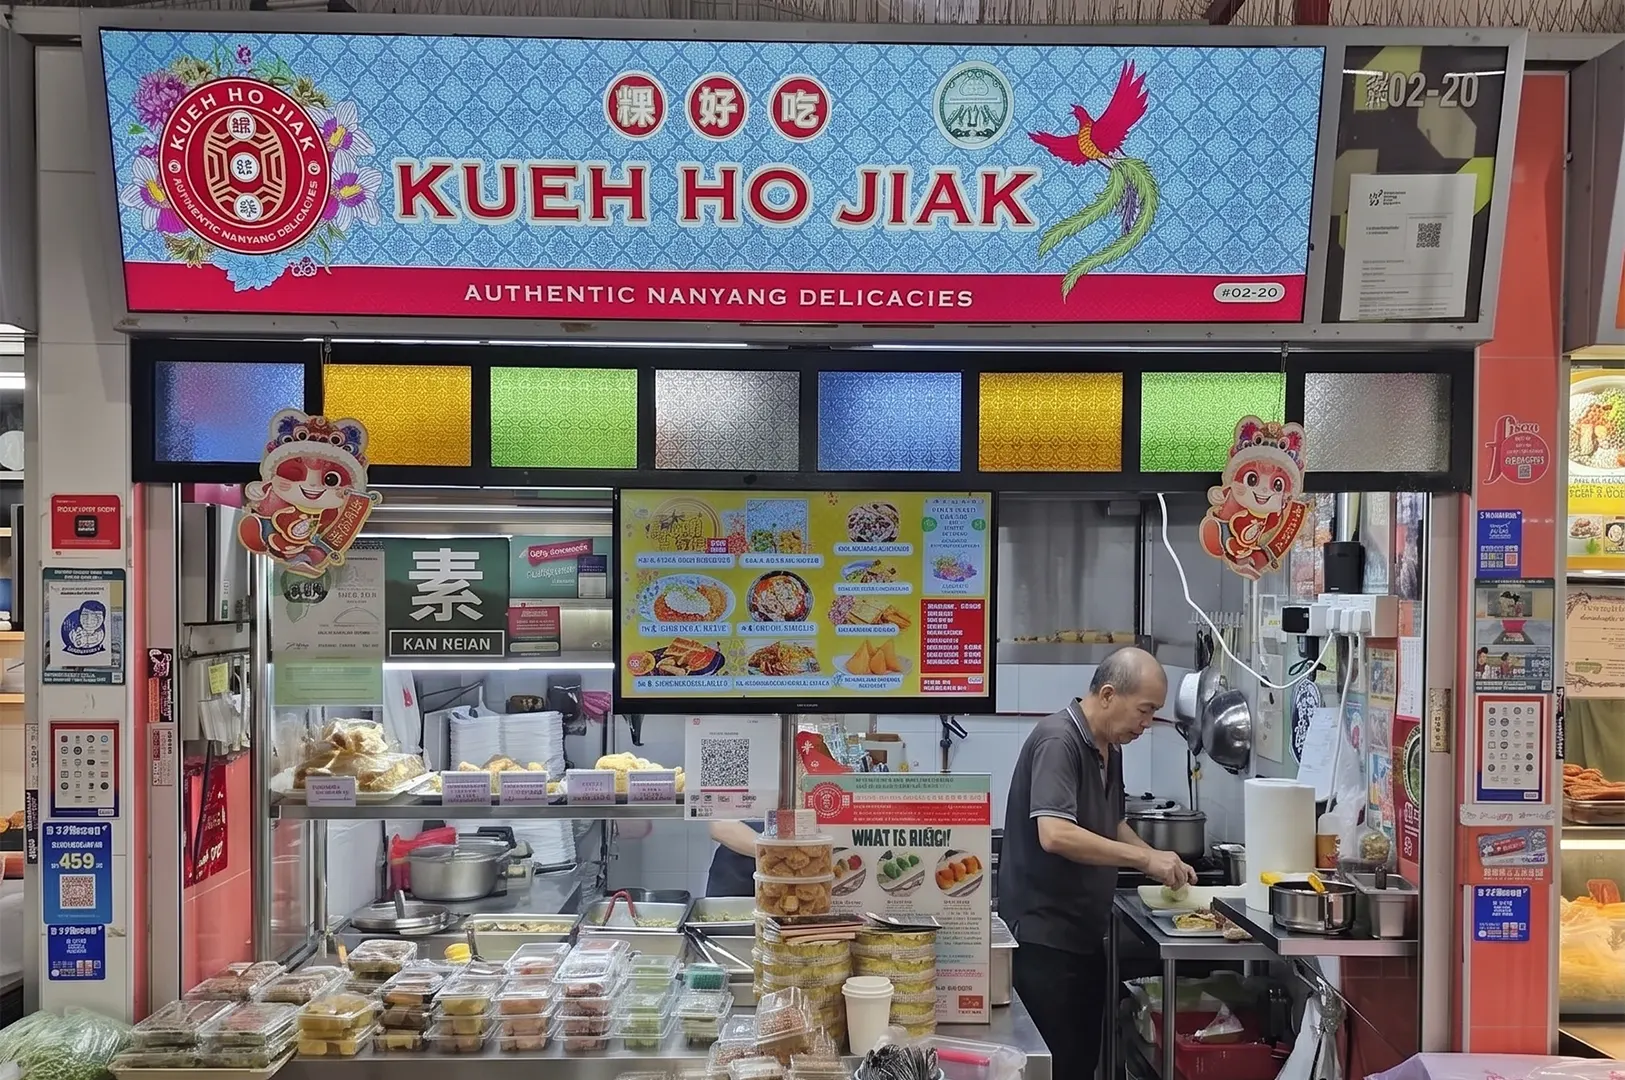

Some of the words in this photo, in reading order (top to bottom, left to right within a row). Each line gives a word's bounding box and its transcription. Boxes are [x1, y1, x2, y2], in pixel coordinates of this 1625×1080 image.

[170, 93, 217, 151] KUEH
[227, 87, 264, 105] HO
[271, 103, 316, 153] JIAK
[394, 162, 650, 222] KUEH
[681, 167, 810, 224] HO
[837, 169, 1037, 227] JIAK
[221, 230, 277, 244] NANYANG
[464, 284, 635, 303] AUTHENTIC
[648, 287, 787, 305] NANYANG
[799, 289, 973, 307] DELICACIES
[1221, 286, 1279, 299] #02-20
[408, 547, 484, 622] 素
[403, 637, 437, 651] KAN
[852, 829, 890, 847] WHAT
[893, 829, 907, 847] IS
[59, 852, 95, 869] 459
